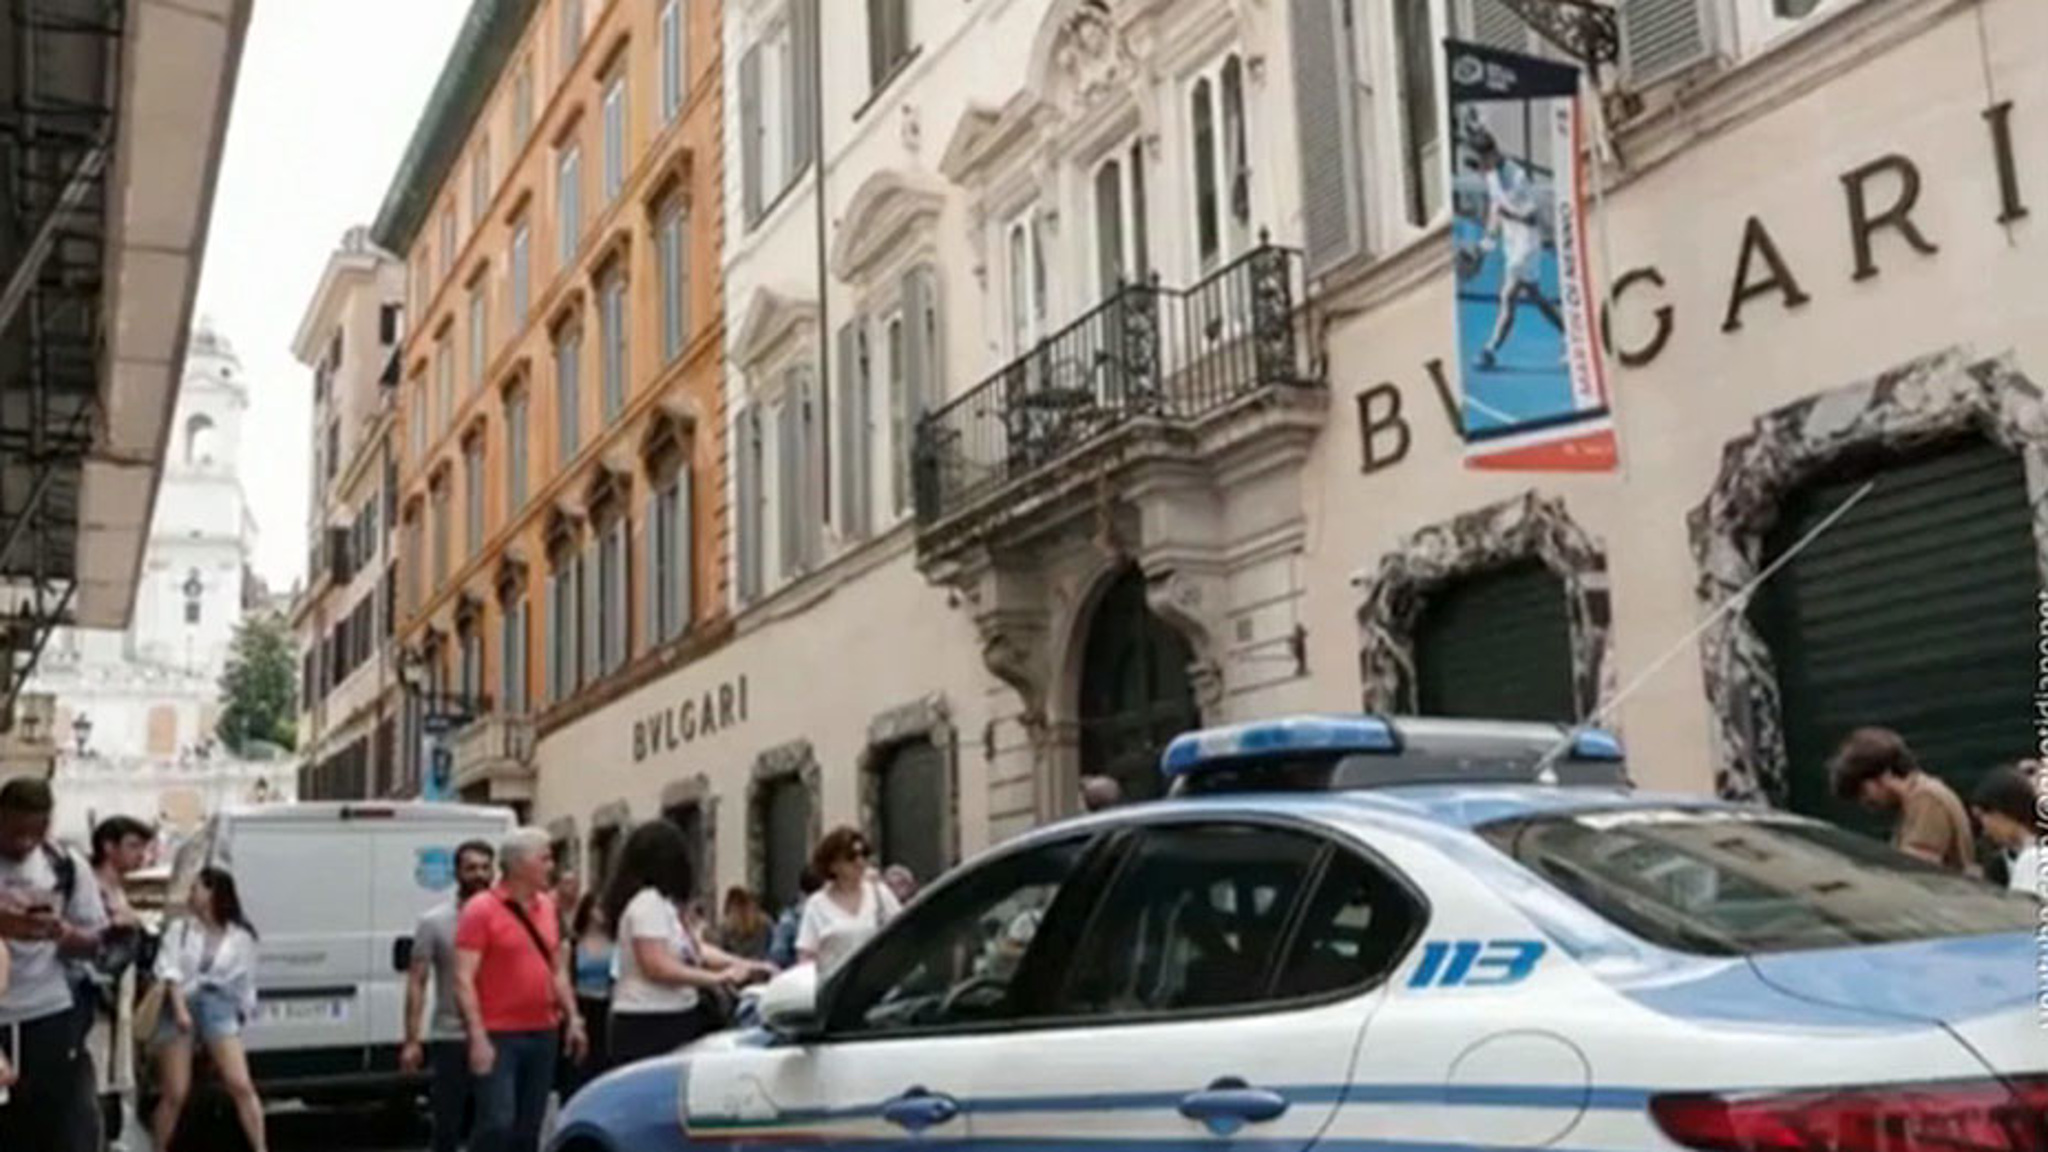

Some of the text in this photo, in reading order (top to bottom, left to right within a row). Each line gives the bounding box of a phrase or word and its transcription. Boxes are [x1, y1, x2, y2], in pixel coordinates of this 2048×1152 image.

[1356, 101, 2029, 475] BVGARI
[633, 673, 748, 762] BVLGARI
[1406, 939, 1546, 988] 113
